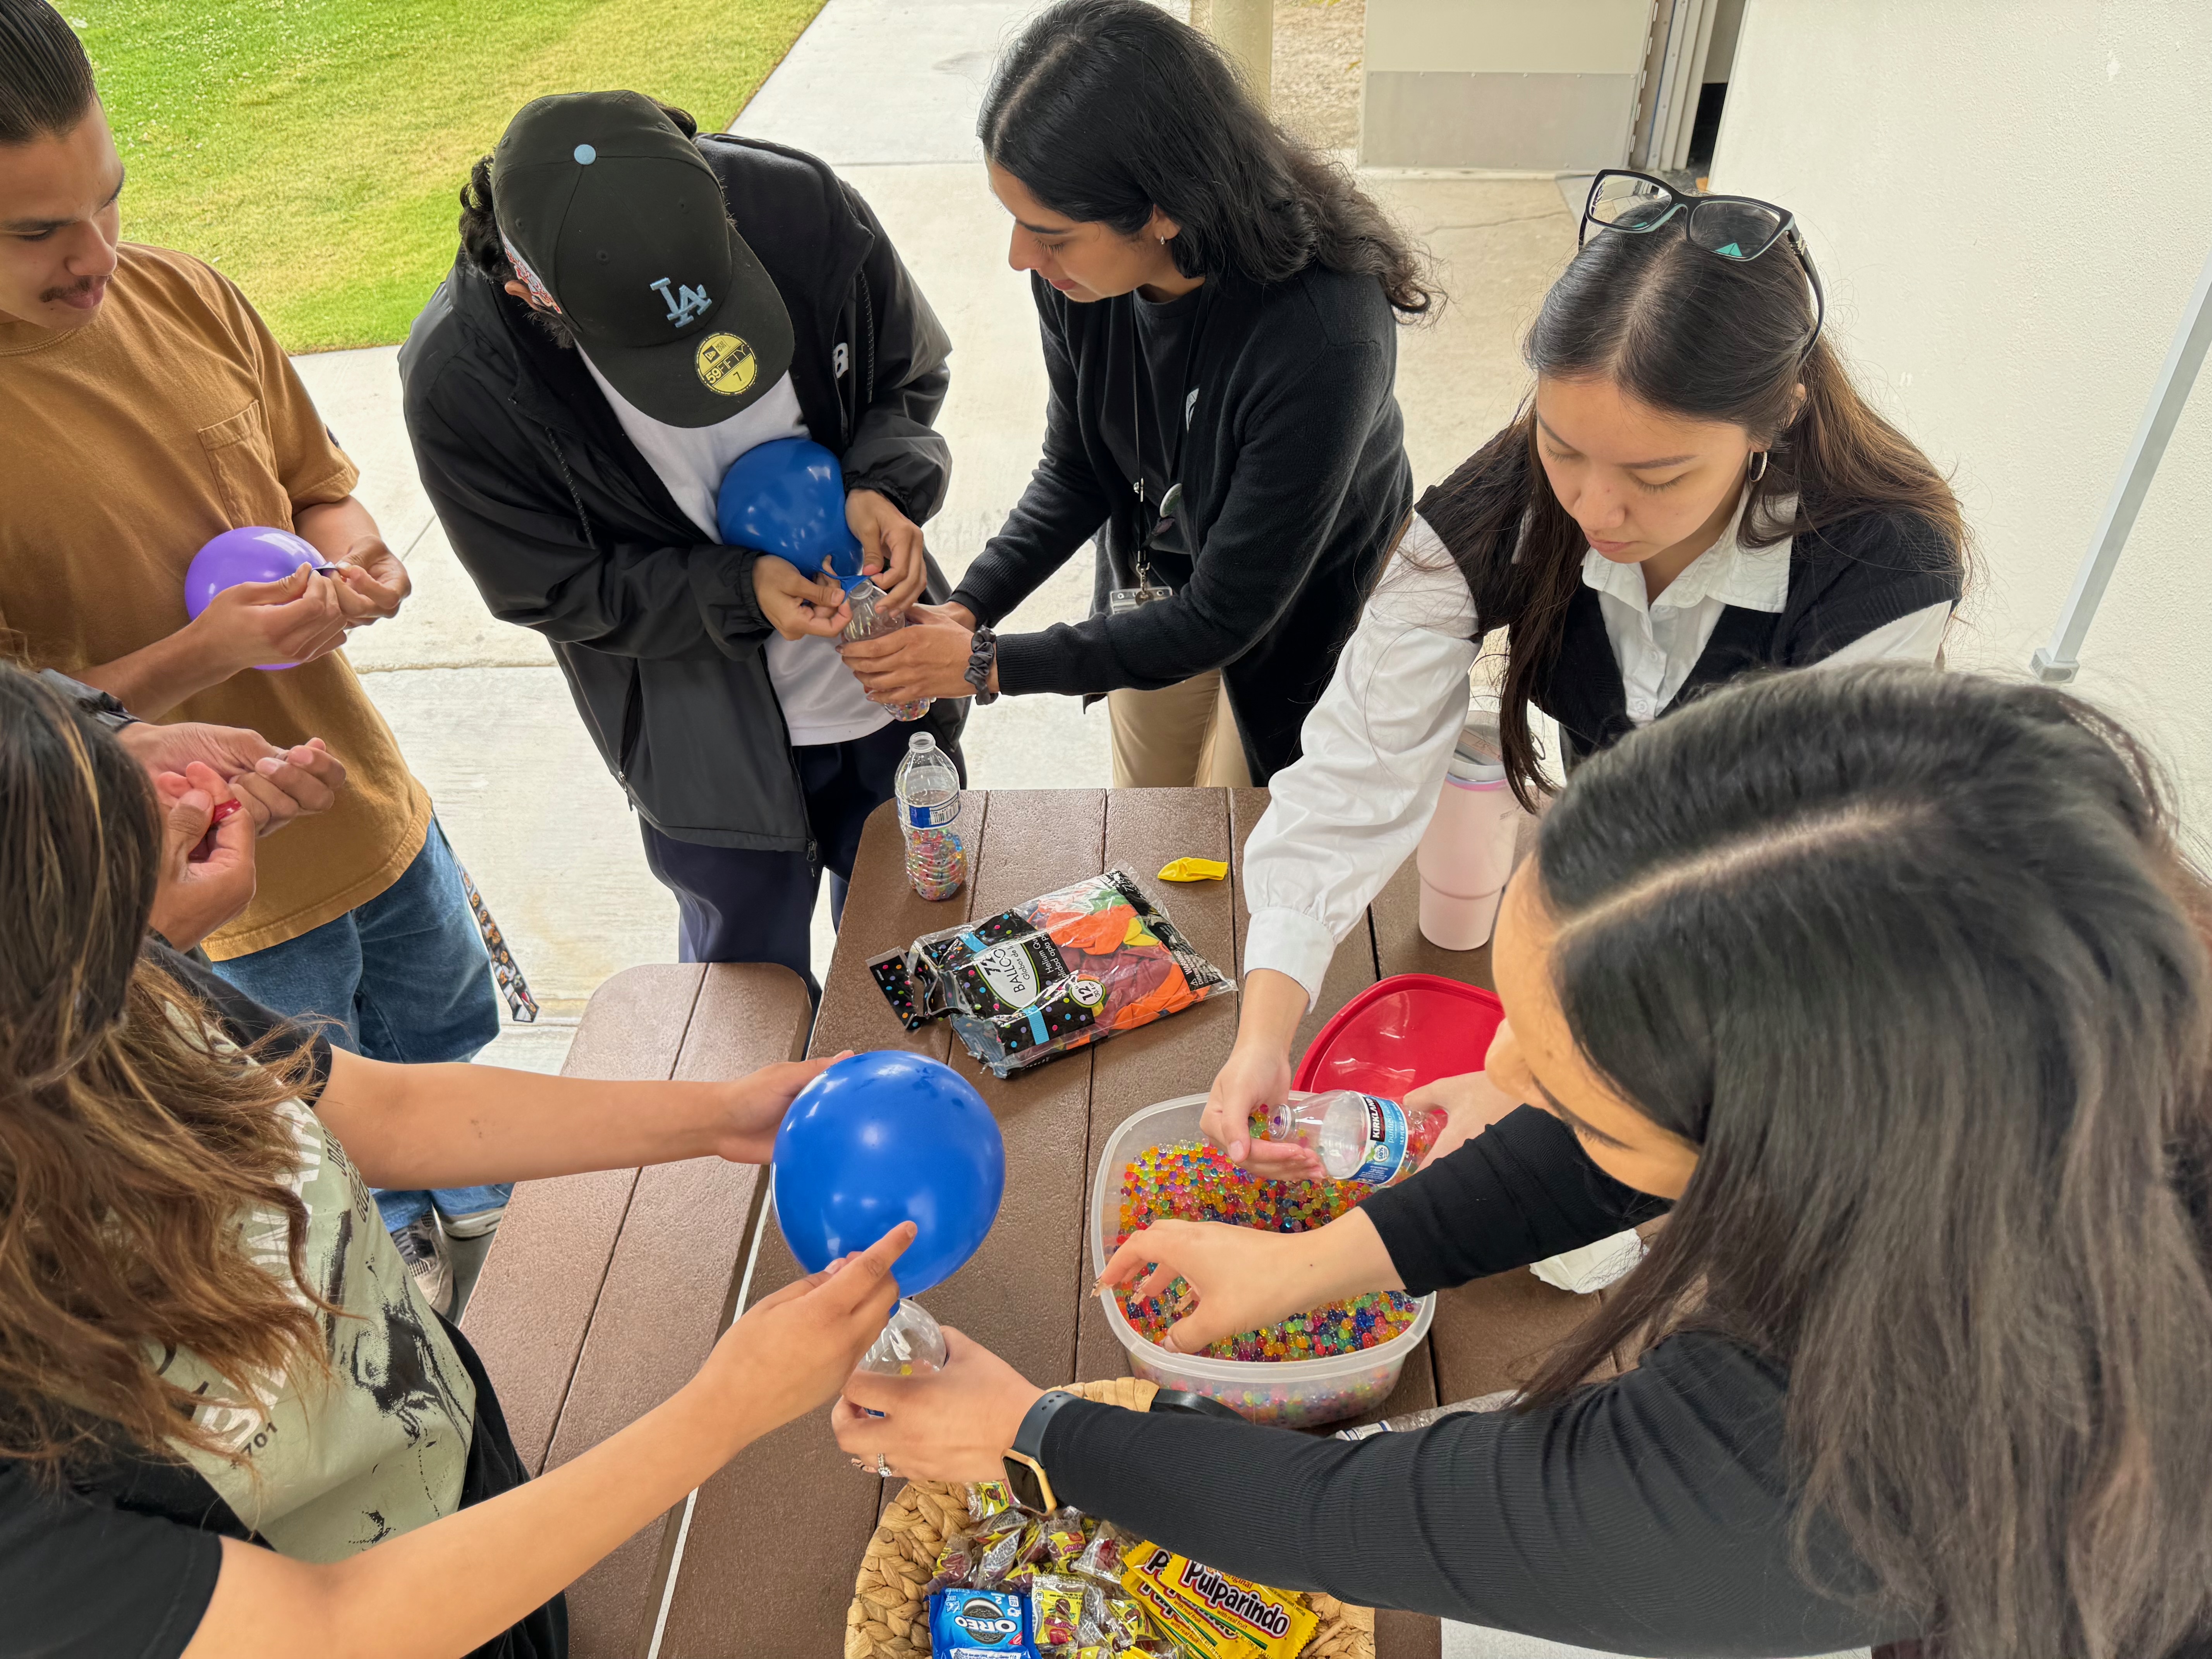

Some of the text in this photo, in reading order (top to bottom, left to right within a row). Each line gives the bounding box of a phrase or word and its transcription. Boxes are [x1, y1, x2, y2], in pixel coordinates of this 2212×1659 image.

[650, 277, 712, 328] LA
[706, 344, 746, 383] 59FIFTY
[733, 371, 742, 381] 7
[993, 948, 1026, 993] BALLOO
[1017, 958, 1030, 980] Globos
[1039, 950, 1054, 973] Helium
[1050, 958, 1067, 978] alidad
[1174, 949, 1192, 975] WARNING
[1365, 1098, 1380, 1139] KIRKLAND
[1225, 1573, 1254, 1589] riginal
[1183, 1560, 1288, 1635] Pulparindo
[1173, 1601, 1201, 1624] with real fruit
[1217, 1609, 1227, 1618] with
[1237, 1620, 1248, 1630] fruit
[955, 1616, 1017, 1633] OREO
[1171, 1621, 1199, 1644] with real fruit
